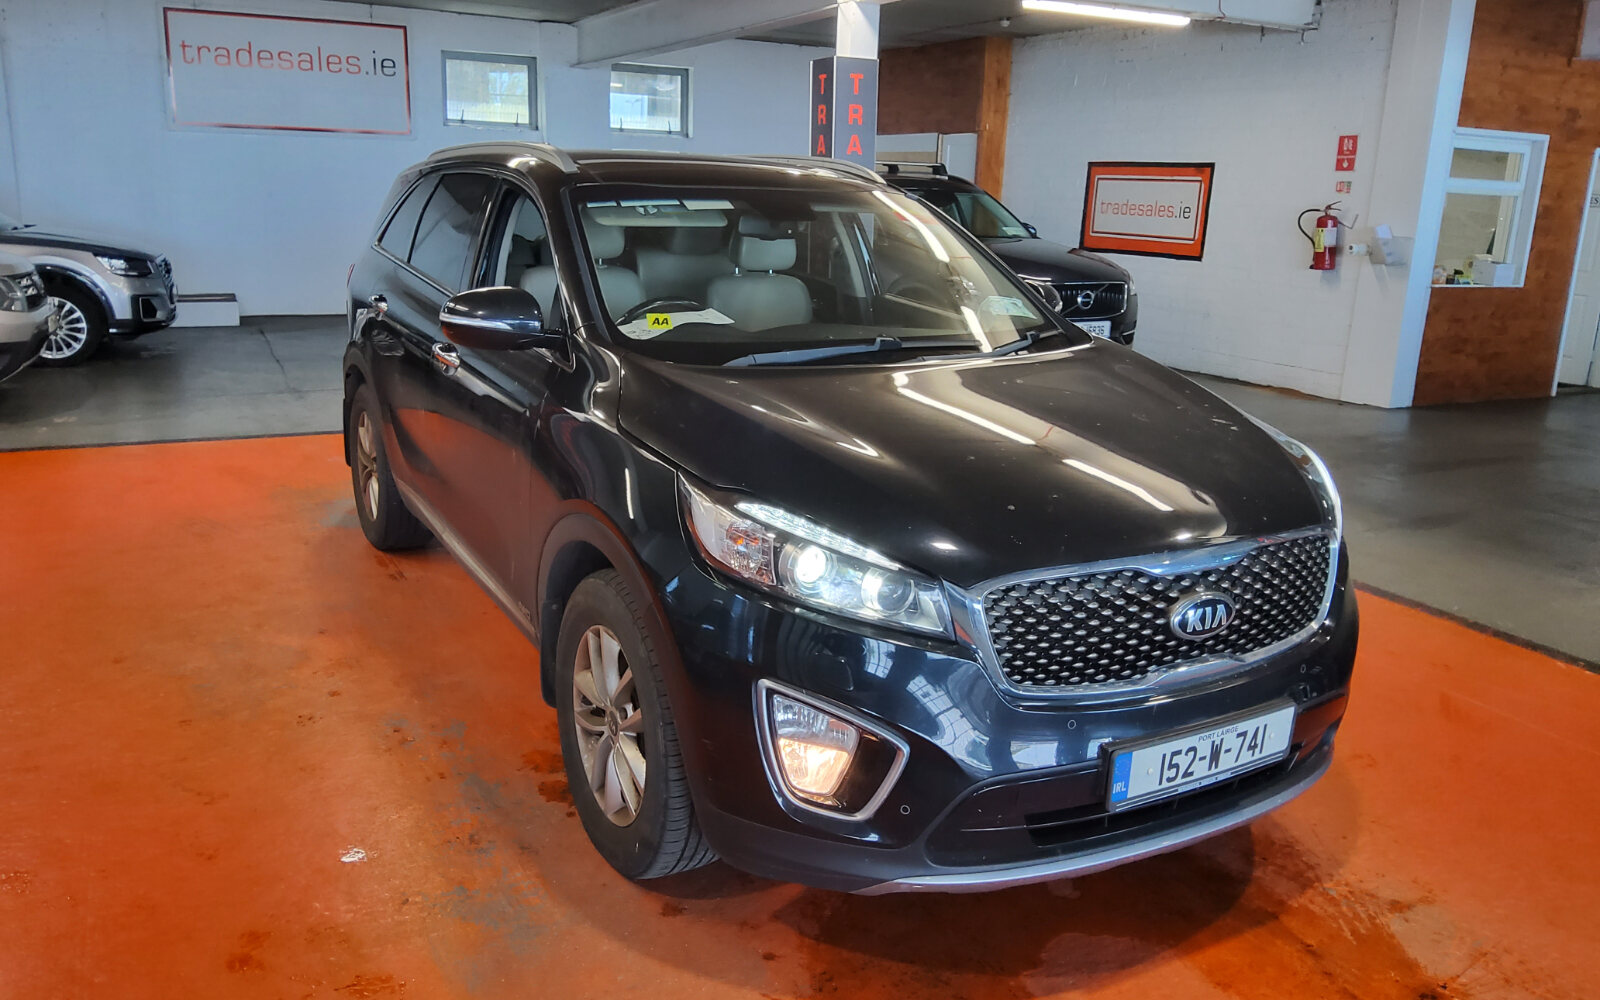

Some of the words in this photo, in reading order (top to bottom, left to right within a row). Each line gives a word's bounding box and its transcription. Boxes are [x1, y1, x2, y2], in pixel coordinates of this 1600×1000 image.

[179, 39, 397, 77] tradesales.ie
[1100, 199, 1192, 220] tradesales.ie
[652, 317, 670, 326] AA
[1186, 604, 1227, 633] KIA
[1158, 723, 1268, 786] 152-W-741
[1112, 782, 1127, 794] IRL
